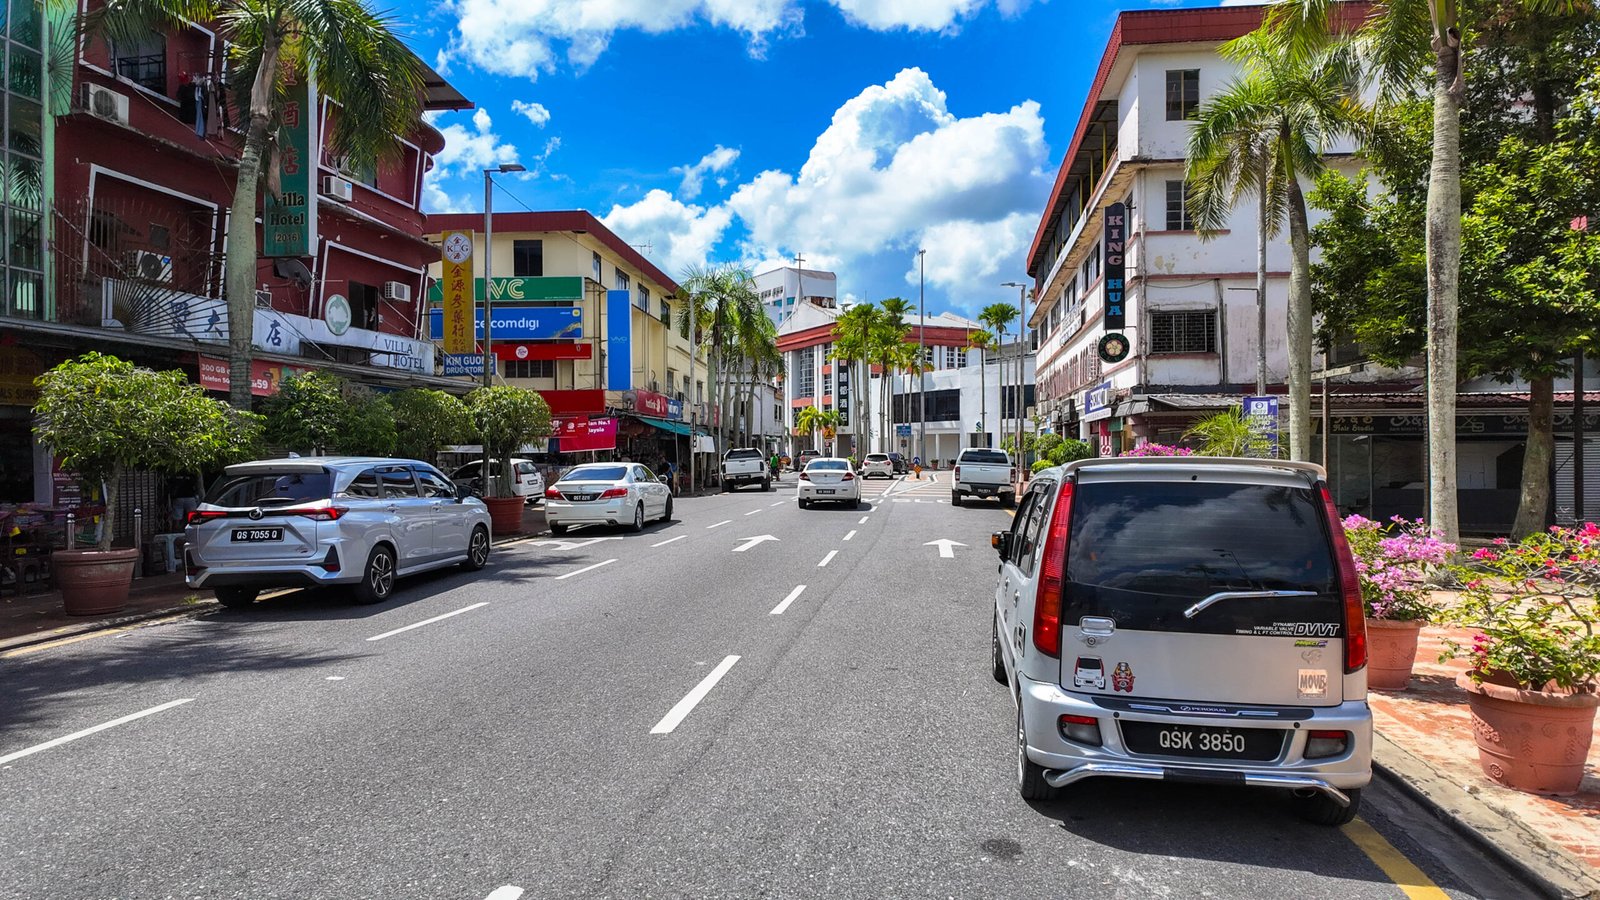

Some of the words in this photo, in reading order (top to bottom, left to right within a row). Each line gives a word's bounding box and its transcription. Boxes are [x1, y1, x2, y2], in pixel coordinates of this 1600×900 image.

[270, 213, 305, 225] Hotel
[1107, 215, 1123, 266] KING
[1107, 279, 1123, 316] HUA
[475, 317, 540, 331] cecomdigi
[384, 339, 414, 355] VILLA
[392, 353, 425, 370] HOTEL
[463, 356, 494, 366] GUOG
[201, 363, 214, 372] 300
[215, 366, 225, 374] GB
[201, 374, 221, 383] Telefon
[237, 531, 248, 539] QS
[250, 531, 270, 539] 7055
[1294, 623, 1341, 637] DVVT
[1160, 730, 1194, 750] QSK
[1199, 733, 1245, 753] 3850
